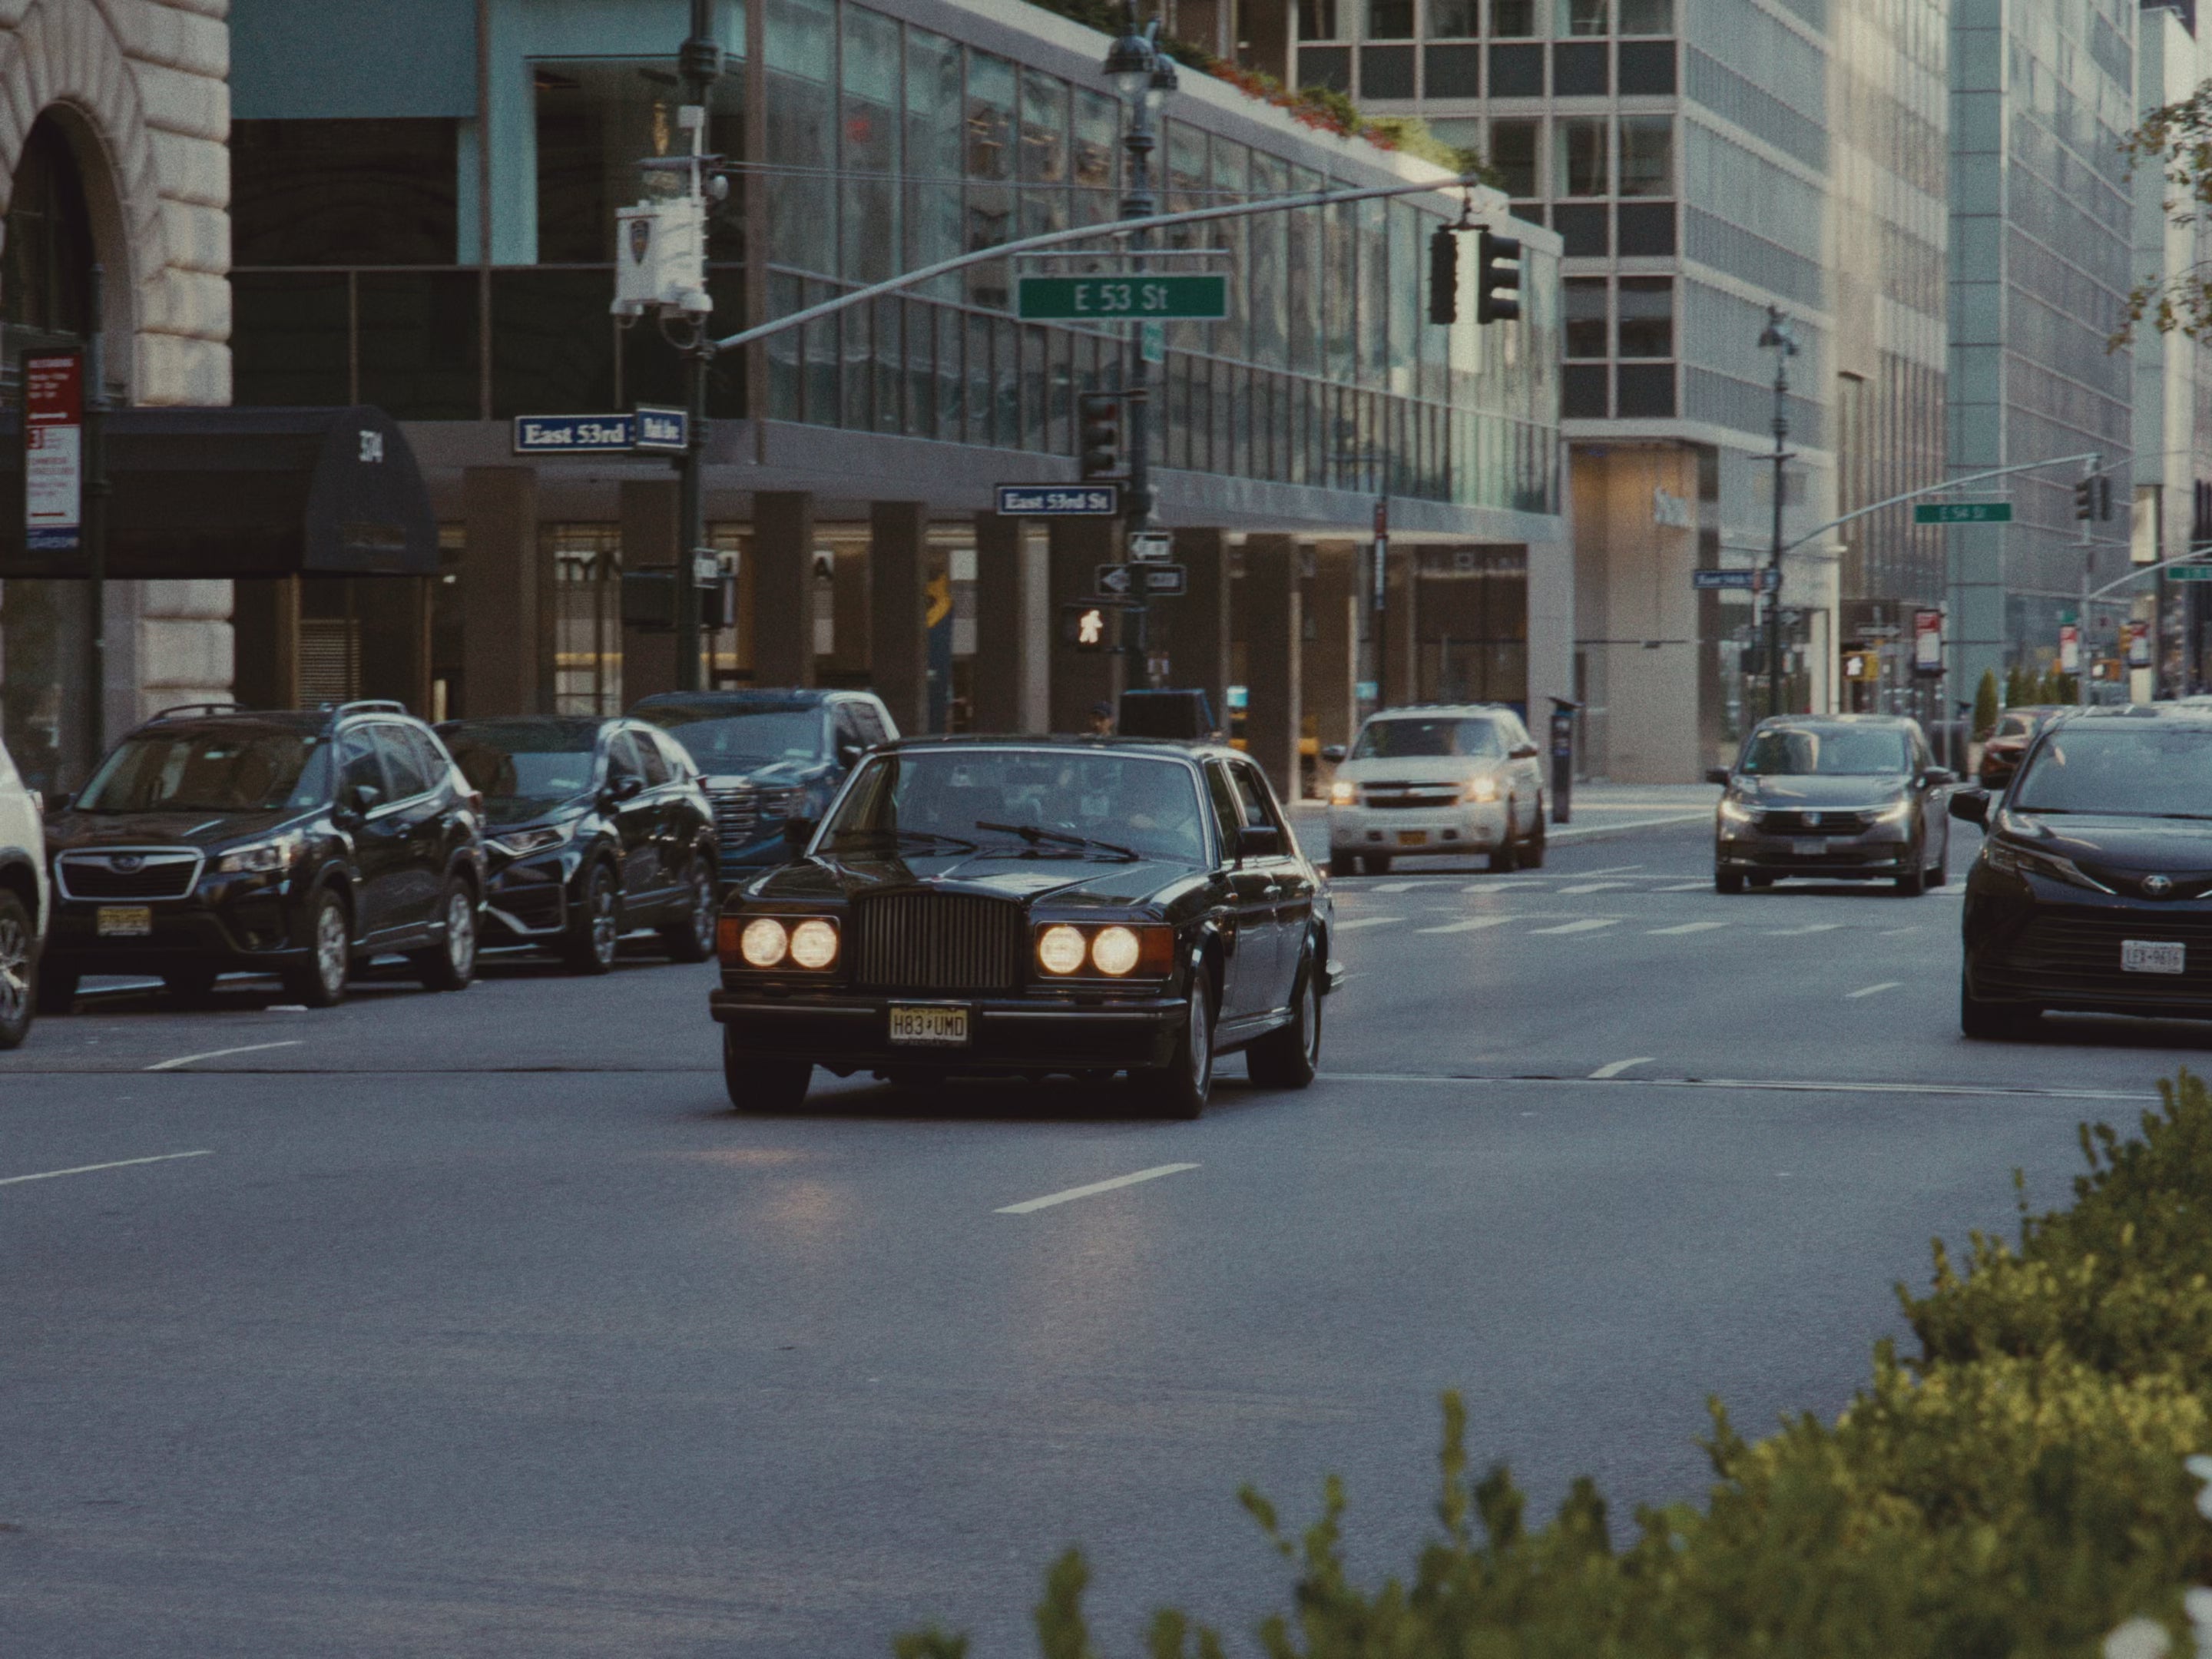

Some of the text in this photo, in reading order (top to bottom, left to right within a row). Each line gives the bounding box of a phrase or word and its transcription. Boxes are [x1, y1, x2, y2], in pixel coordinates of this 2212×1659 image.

[1075, 283, 1168, 311] E 53 St
[524, 423, 573, 445] East
[577, 422, 625, 445] 53rd
[1004, 492, 1108, 509] East 53rd St
